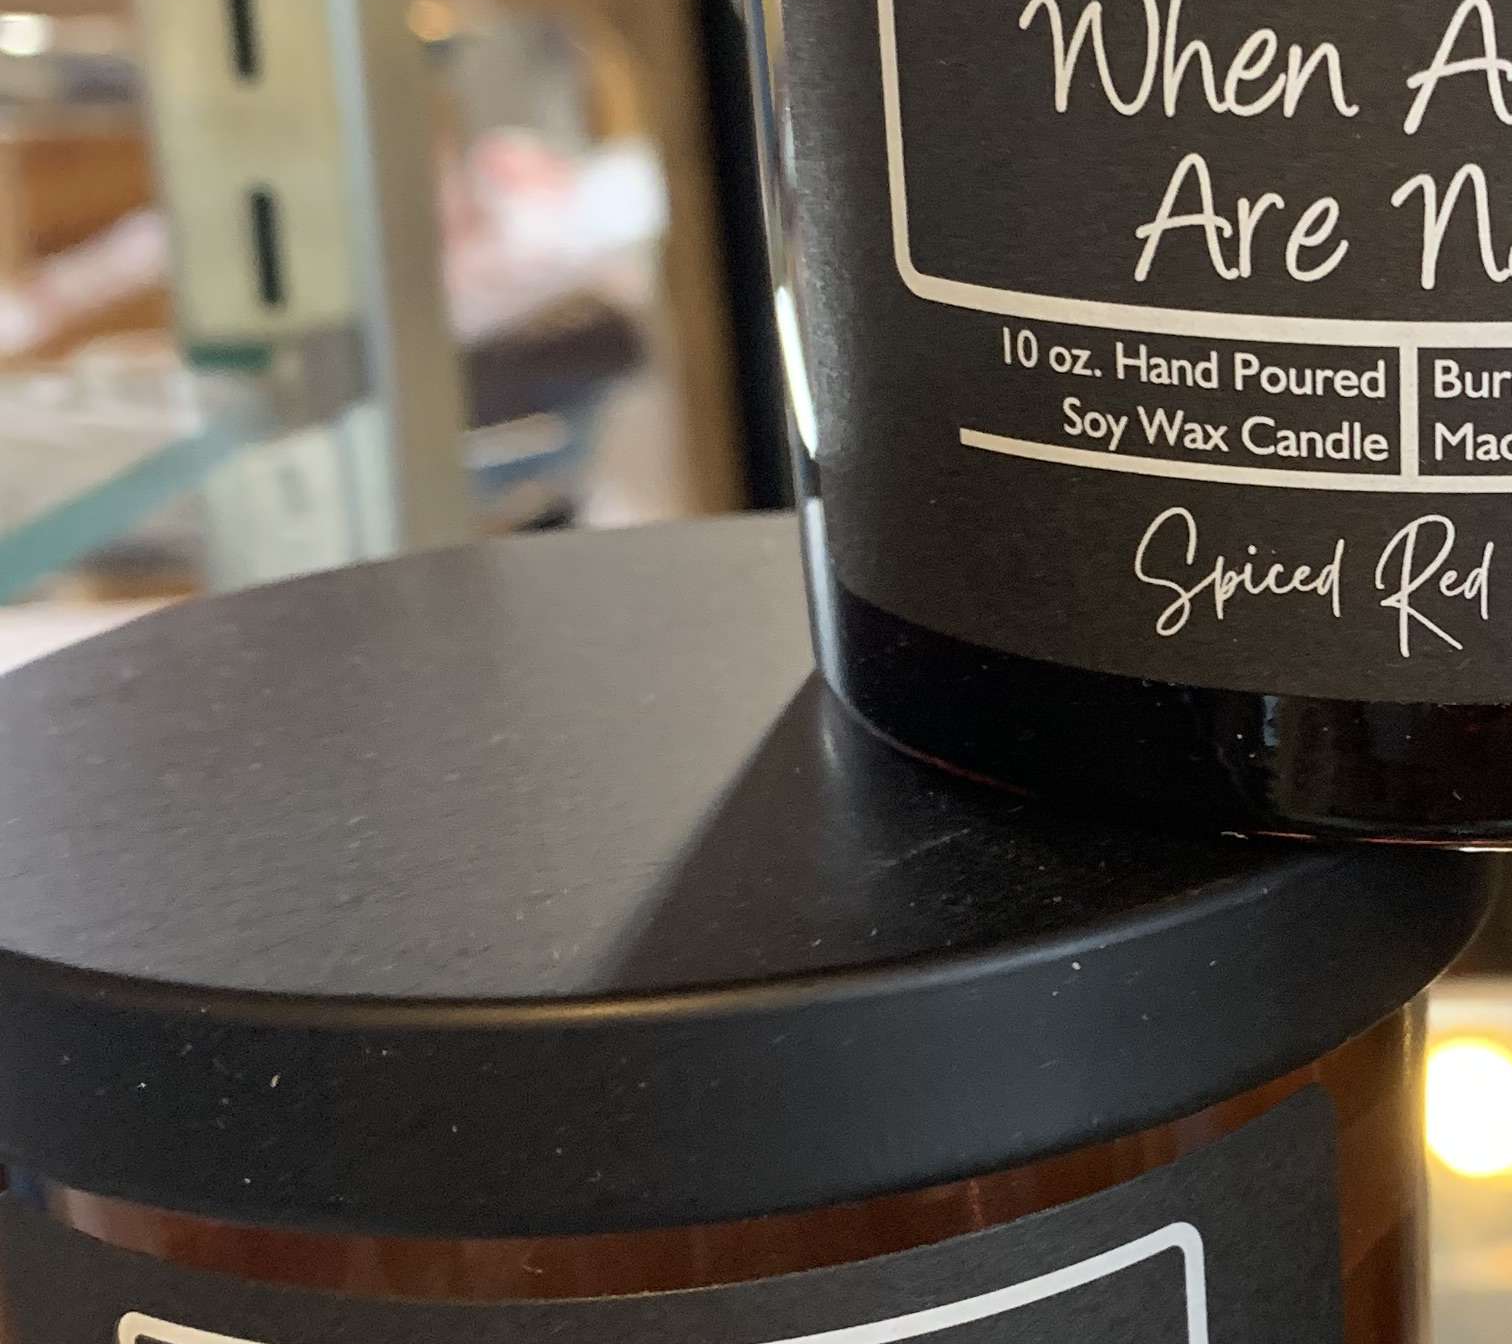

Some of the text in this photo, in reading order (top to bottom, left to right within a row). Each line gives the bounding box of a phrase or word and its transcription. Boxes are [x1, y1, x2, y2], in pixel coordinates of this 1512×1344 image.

[1134, 153, 1348, 283] Are
[1003, 327, 1386, 398] 10 oz. Hand Poured
[1059, 397, 1389, 460] Soy Wax Candle
[1134, 506, 1345, 635] Spiced
[1374, 514, 1490, 656] Red
